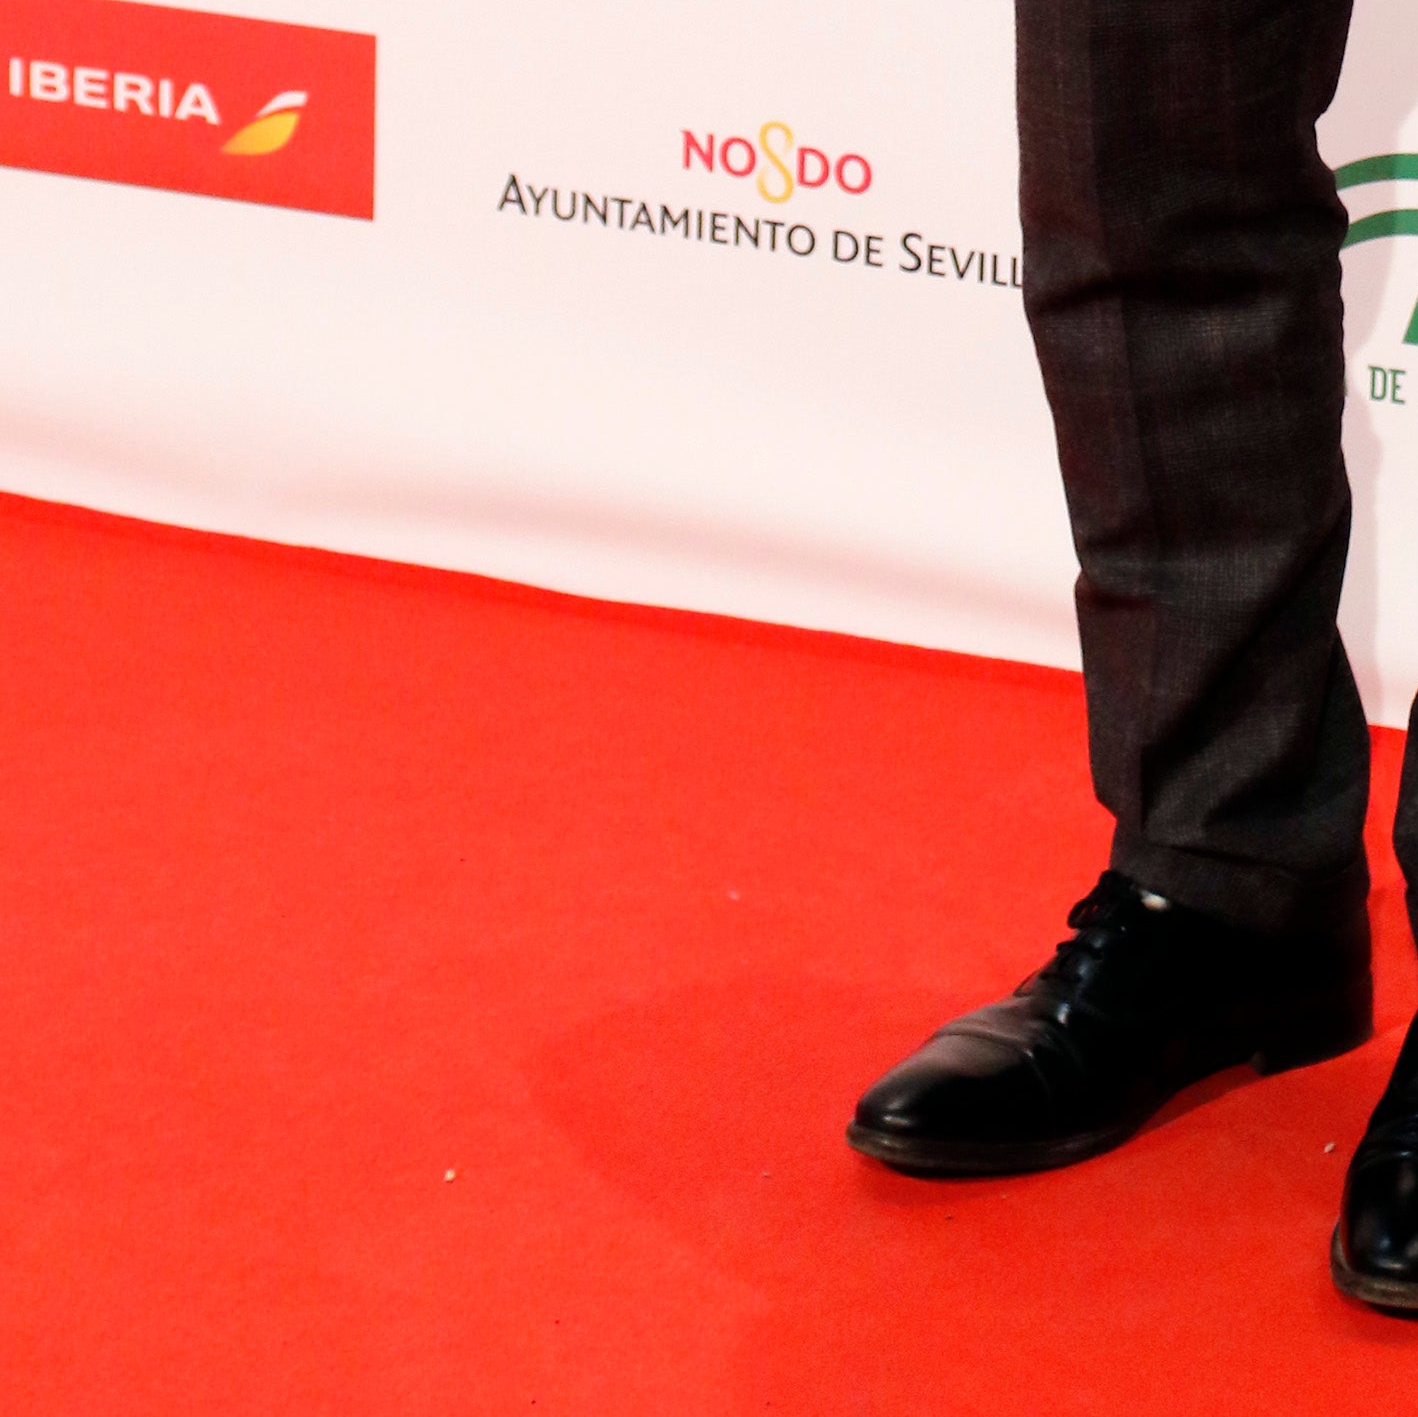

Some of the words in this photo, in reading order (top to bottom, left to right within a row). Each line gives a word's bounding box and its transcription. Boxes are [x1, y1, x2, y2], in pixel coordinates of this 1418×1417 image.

[8, 57, 222, 126] IBERIA
[497, 174, 817, 257] AYUNTAMIENTO
[832, 230, 884, 267] DE
[1368, 365, 1407, 405] DE
